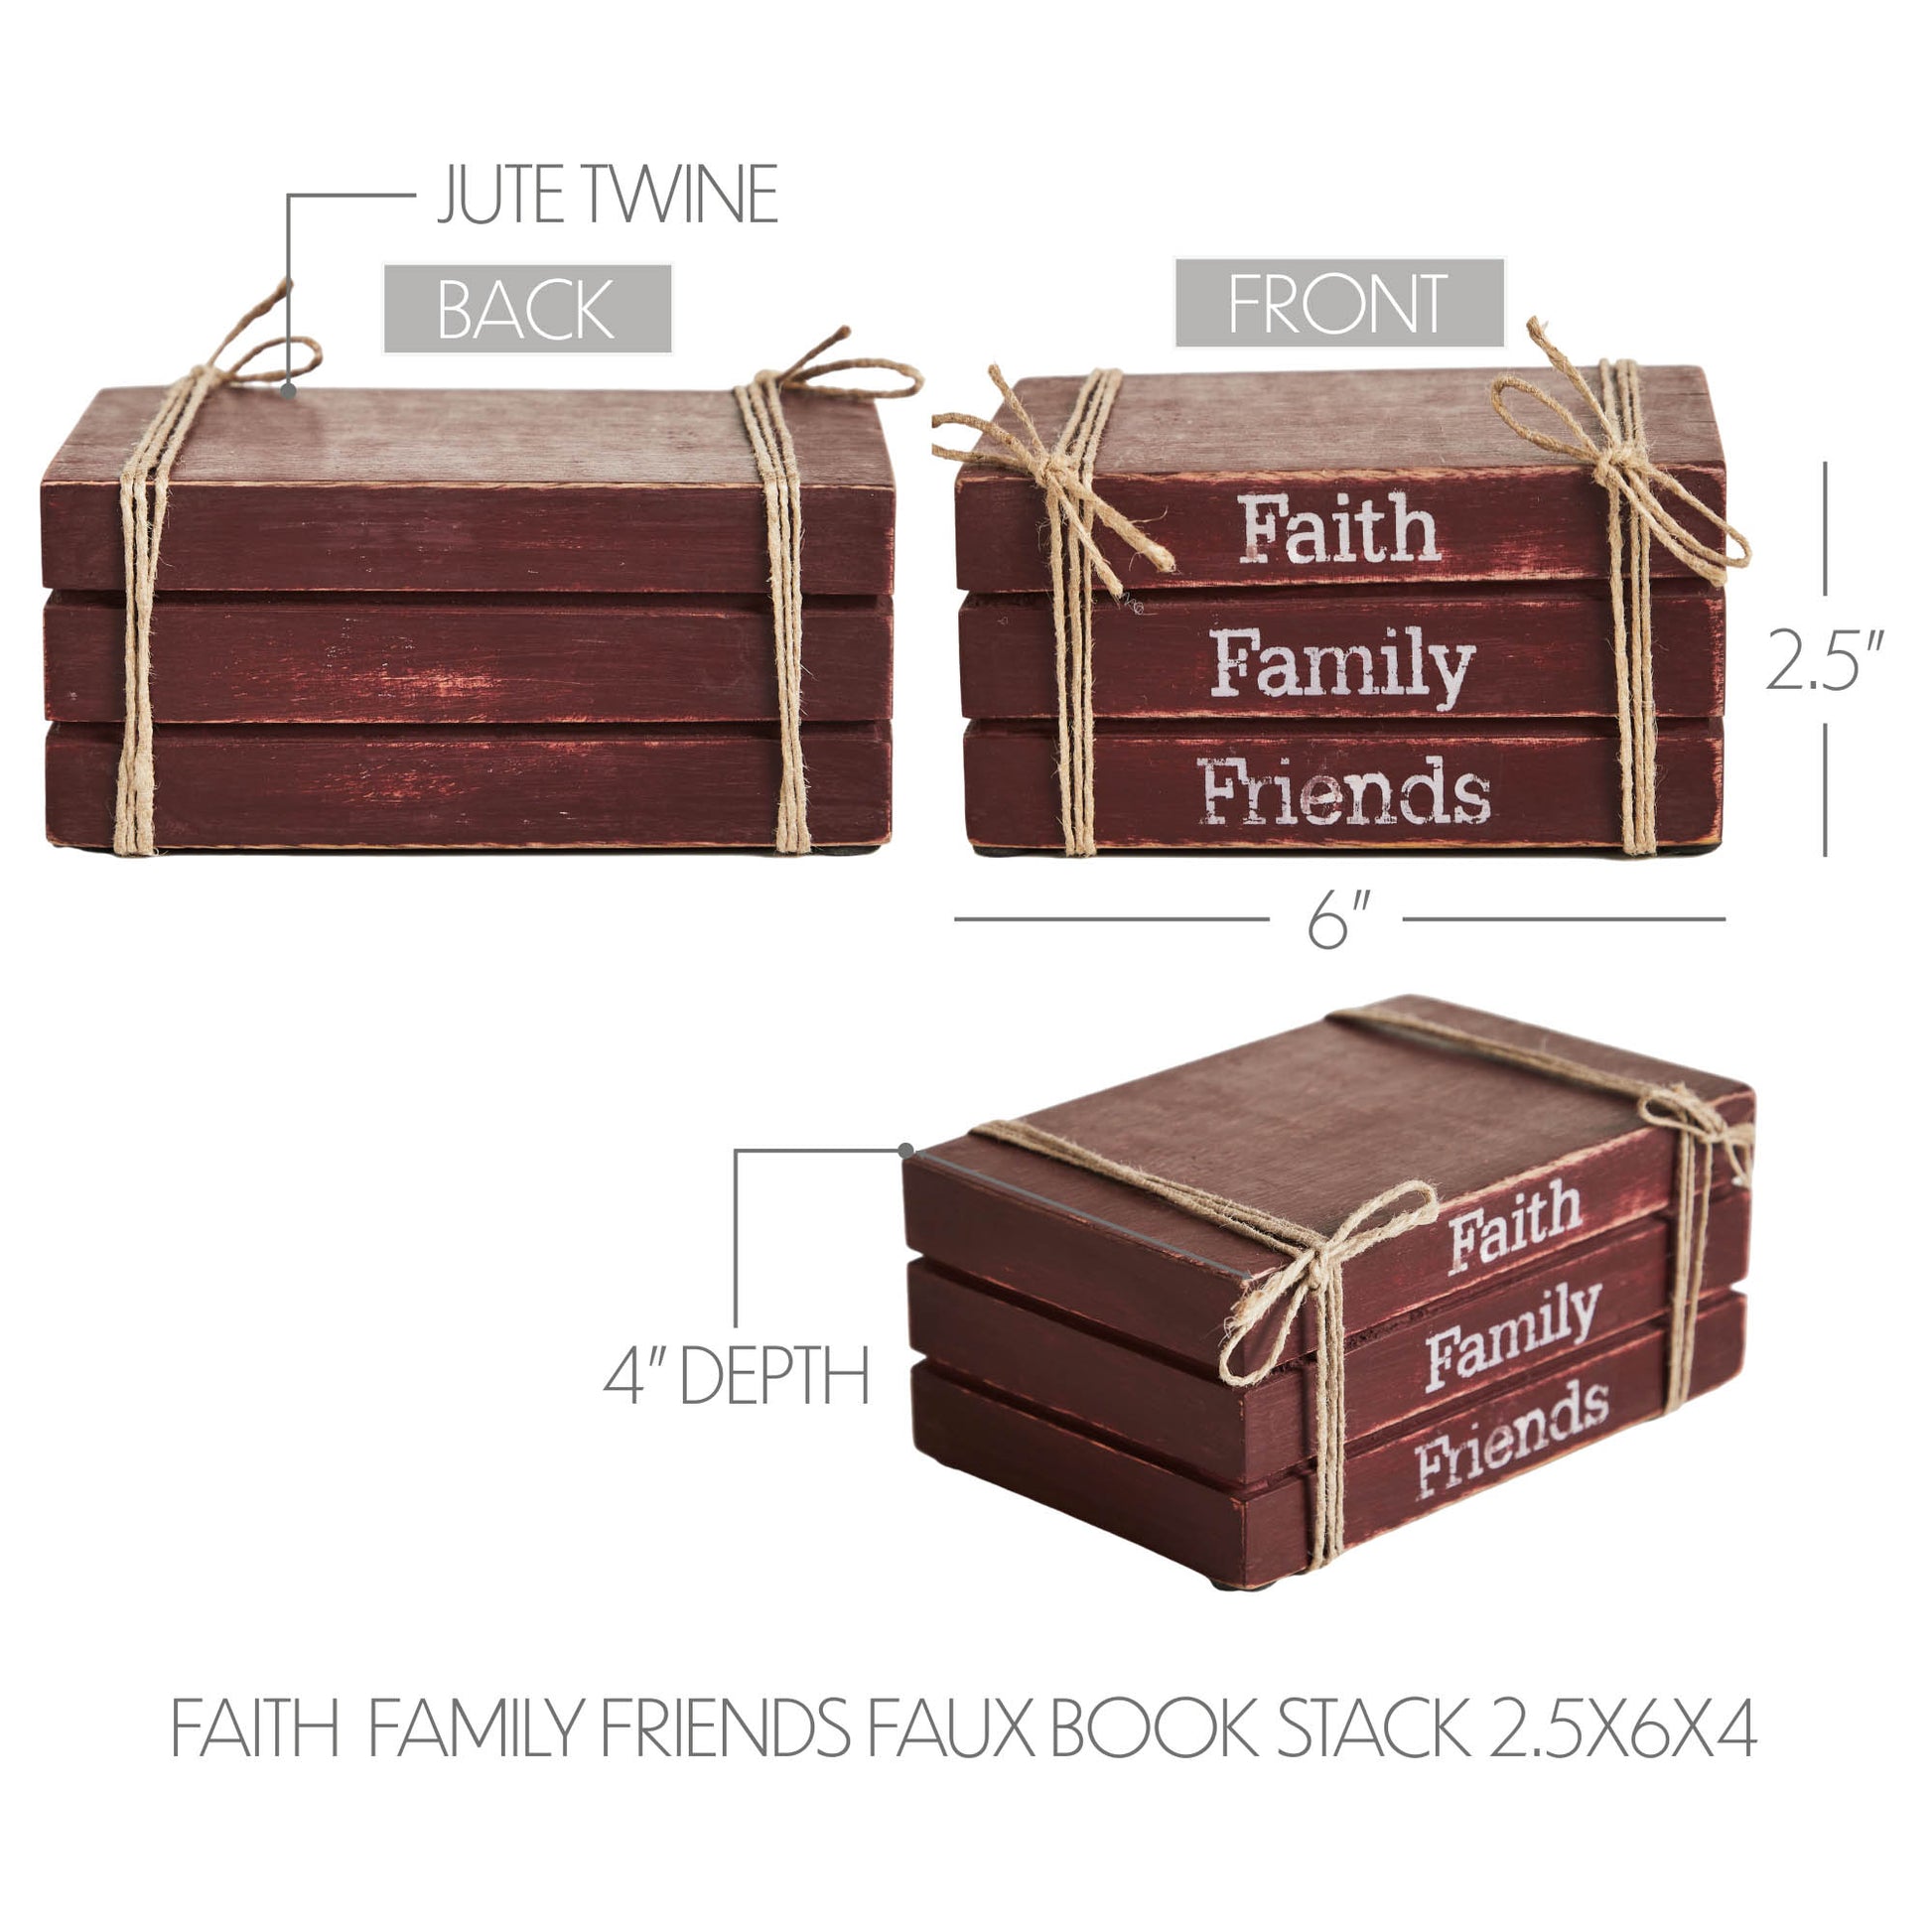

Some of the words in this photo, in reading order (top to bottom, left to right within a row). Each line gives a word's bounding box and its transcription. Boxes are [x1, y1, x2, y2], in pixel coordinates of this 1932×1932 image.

[1237, 491, 1443, 565] Faith
[1209, 626, 1477, 713] Family
[1196, 755, 1491, 826] Friends
[1448, 1178, 1584, 1277] Faith
[1425, 1282, 1603, 1394] Family
[1414, 1378, 1610, 1502] Friends
